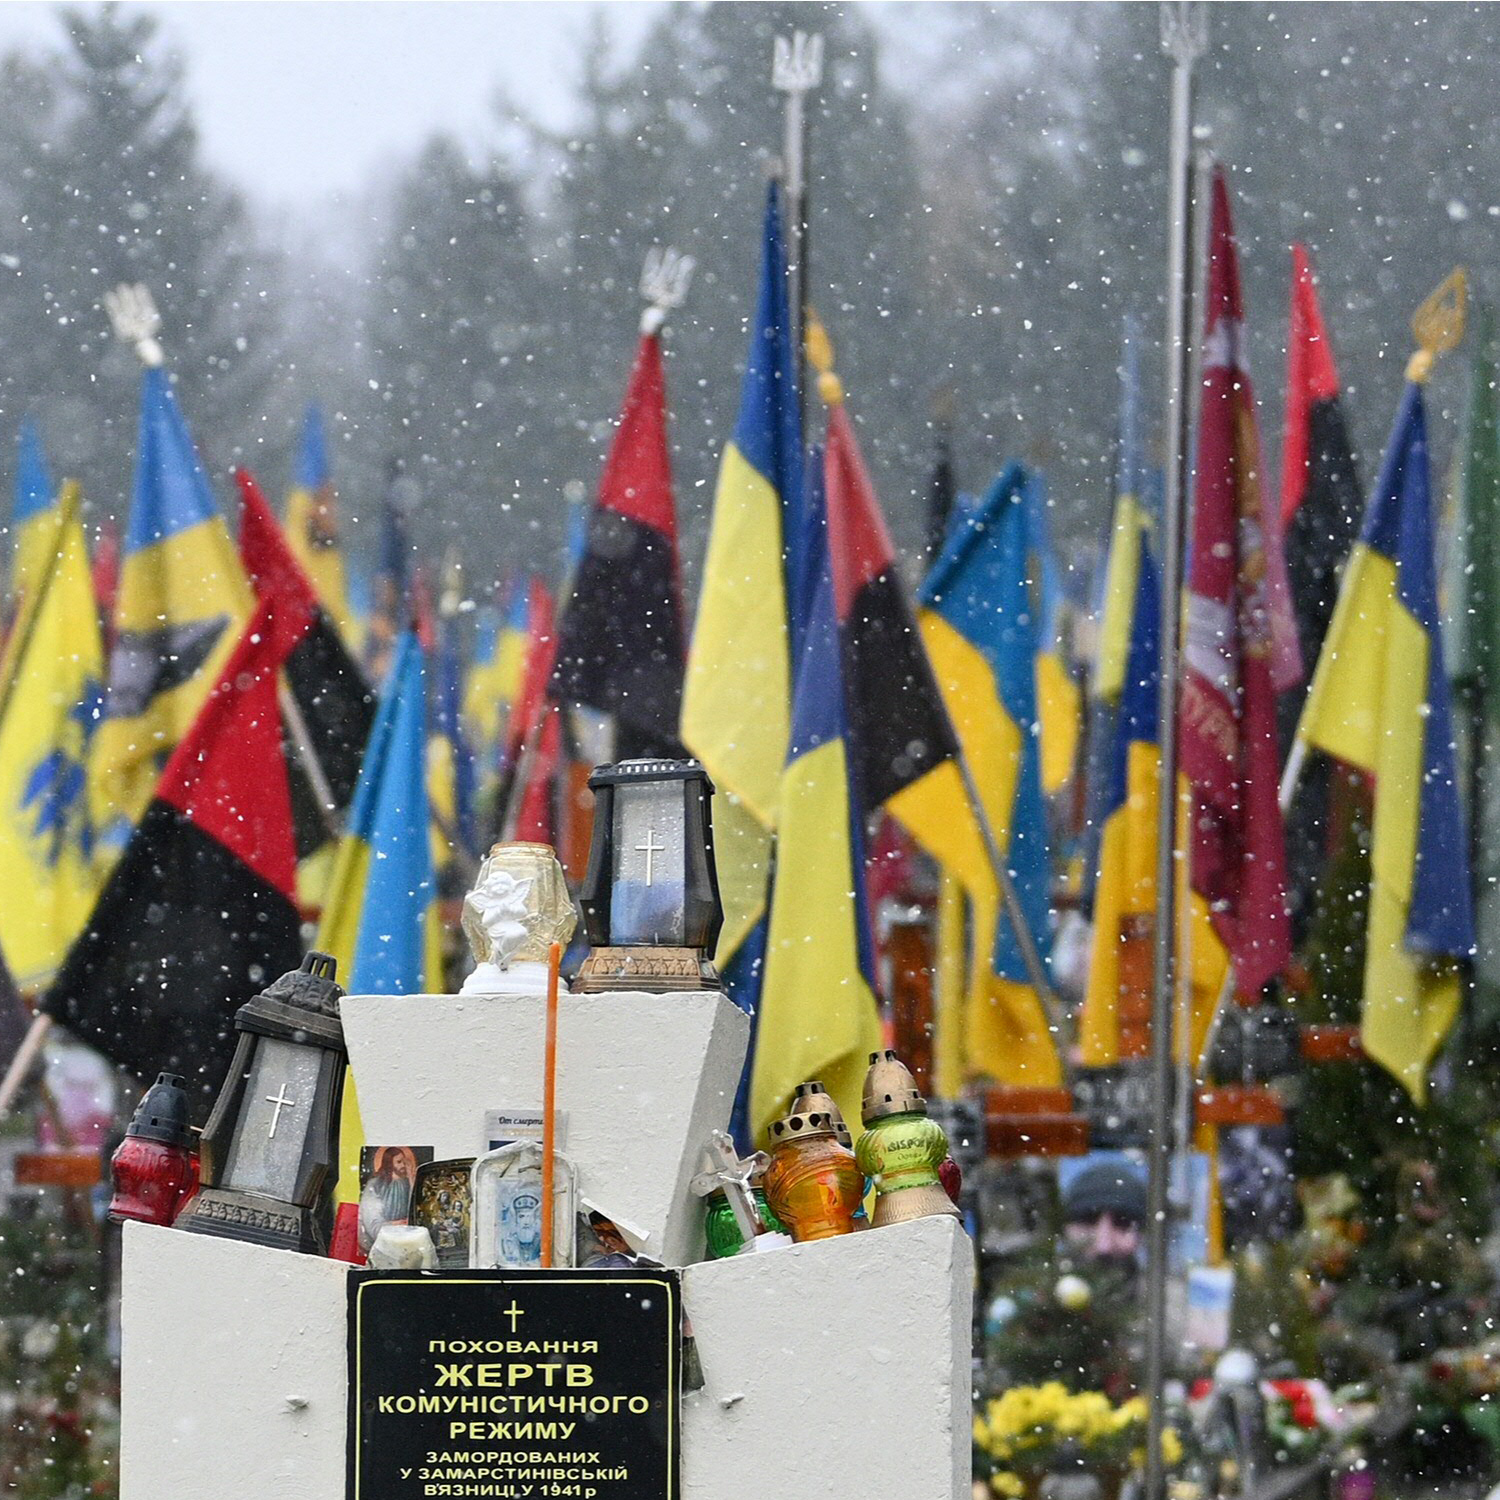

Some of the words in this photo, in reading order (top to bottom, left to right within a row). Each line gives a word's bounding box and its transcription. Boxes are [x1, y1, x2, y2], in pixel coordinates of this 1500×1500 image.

[429, 1341, 597, 1353] ПОХОВАННЯ
[435, 1364, 593, 1387] ЖЕРТВ
[379, 1396, 648, 1413] КОМУНІСТИЧНОГО
[451, 1422, 575, 1439] РЕЖИМУ
[427, 1452, 599, 1465] ЗАМОРДОВАНИХ
[400, 1468, 412, 1479] У
[419, 1464, 627, 1479] ЗАМАРСТИНІВСЬКІЙ
[522, 1485, 533, 1495] У
[540, 1484, 580, 1496] 1941
[586, 1488, 596, 1499] р
